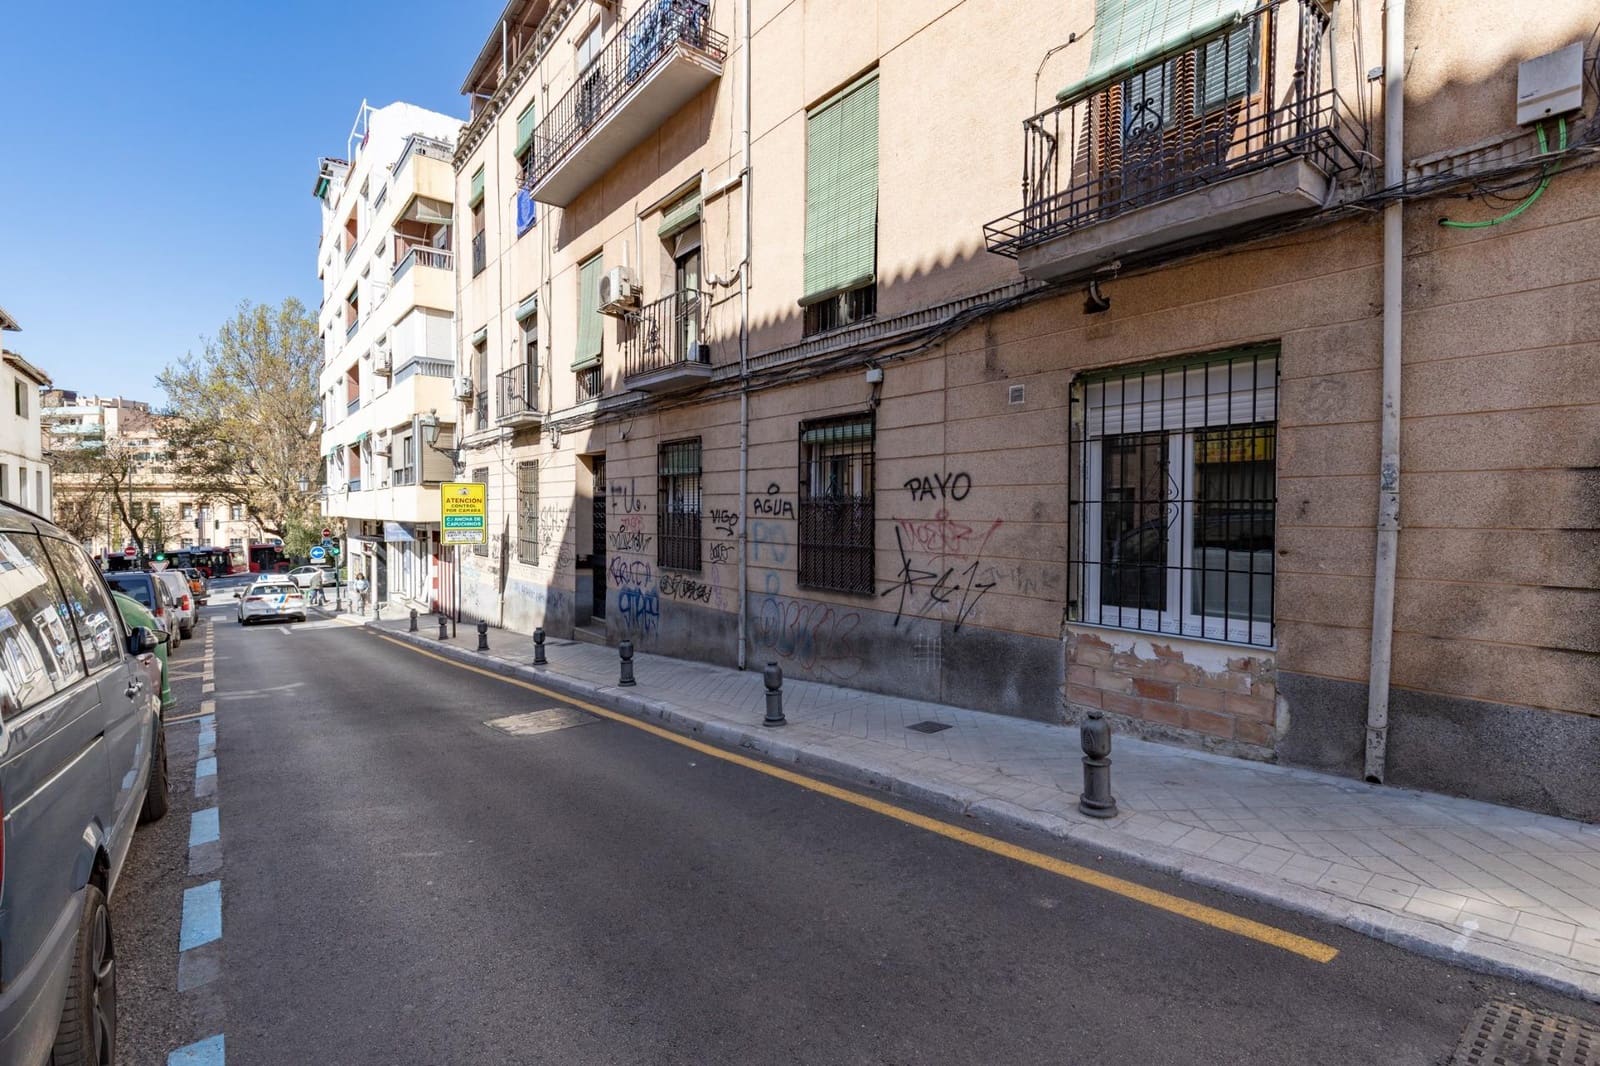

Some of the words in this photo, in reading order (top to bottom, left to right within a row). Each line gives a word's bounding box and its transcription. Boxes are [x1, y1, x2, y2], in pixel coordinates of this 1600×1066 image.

[904, 472, 971, 501] PAYO
[710, 509, 739, 526] VIGO
[754, 498, 795, 520] AGUA
